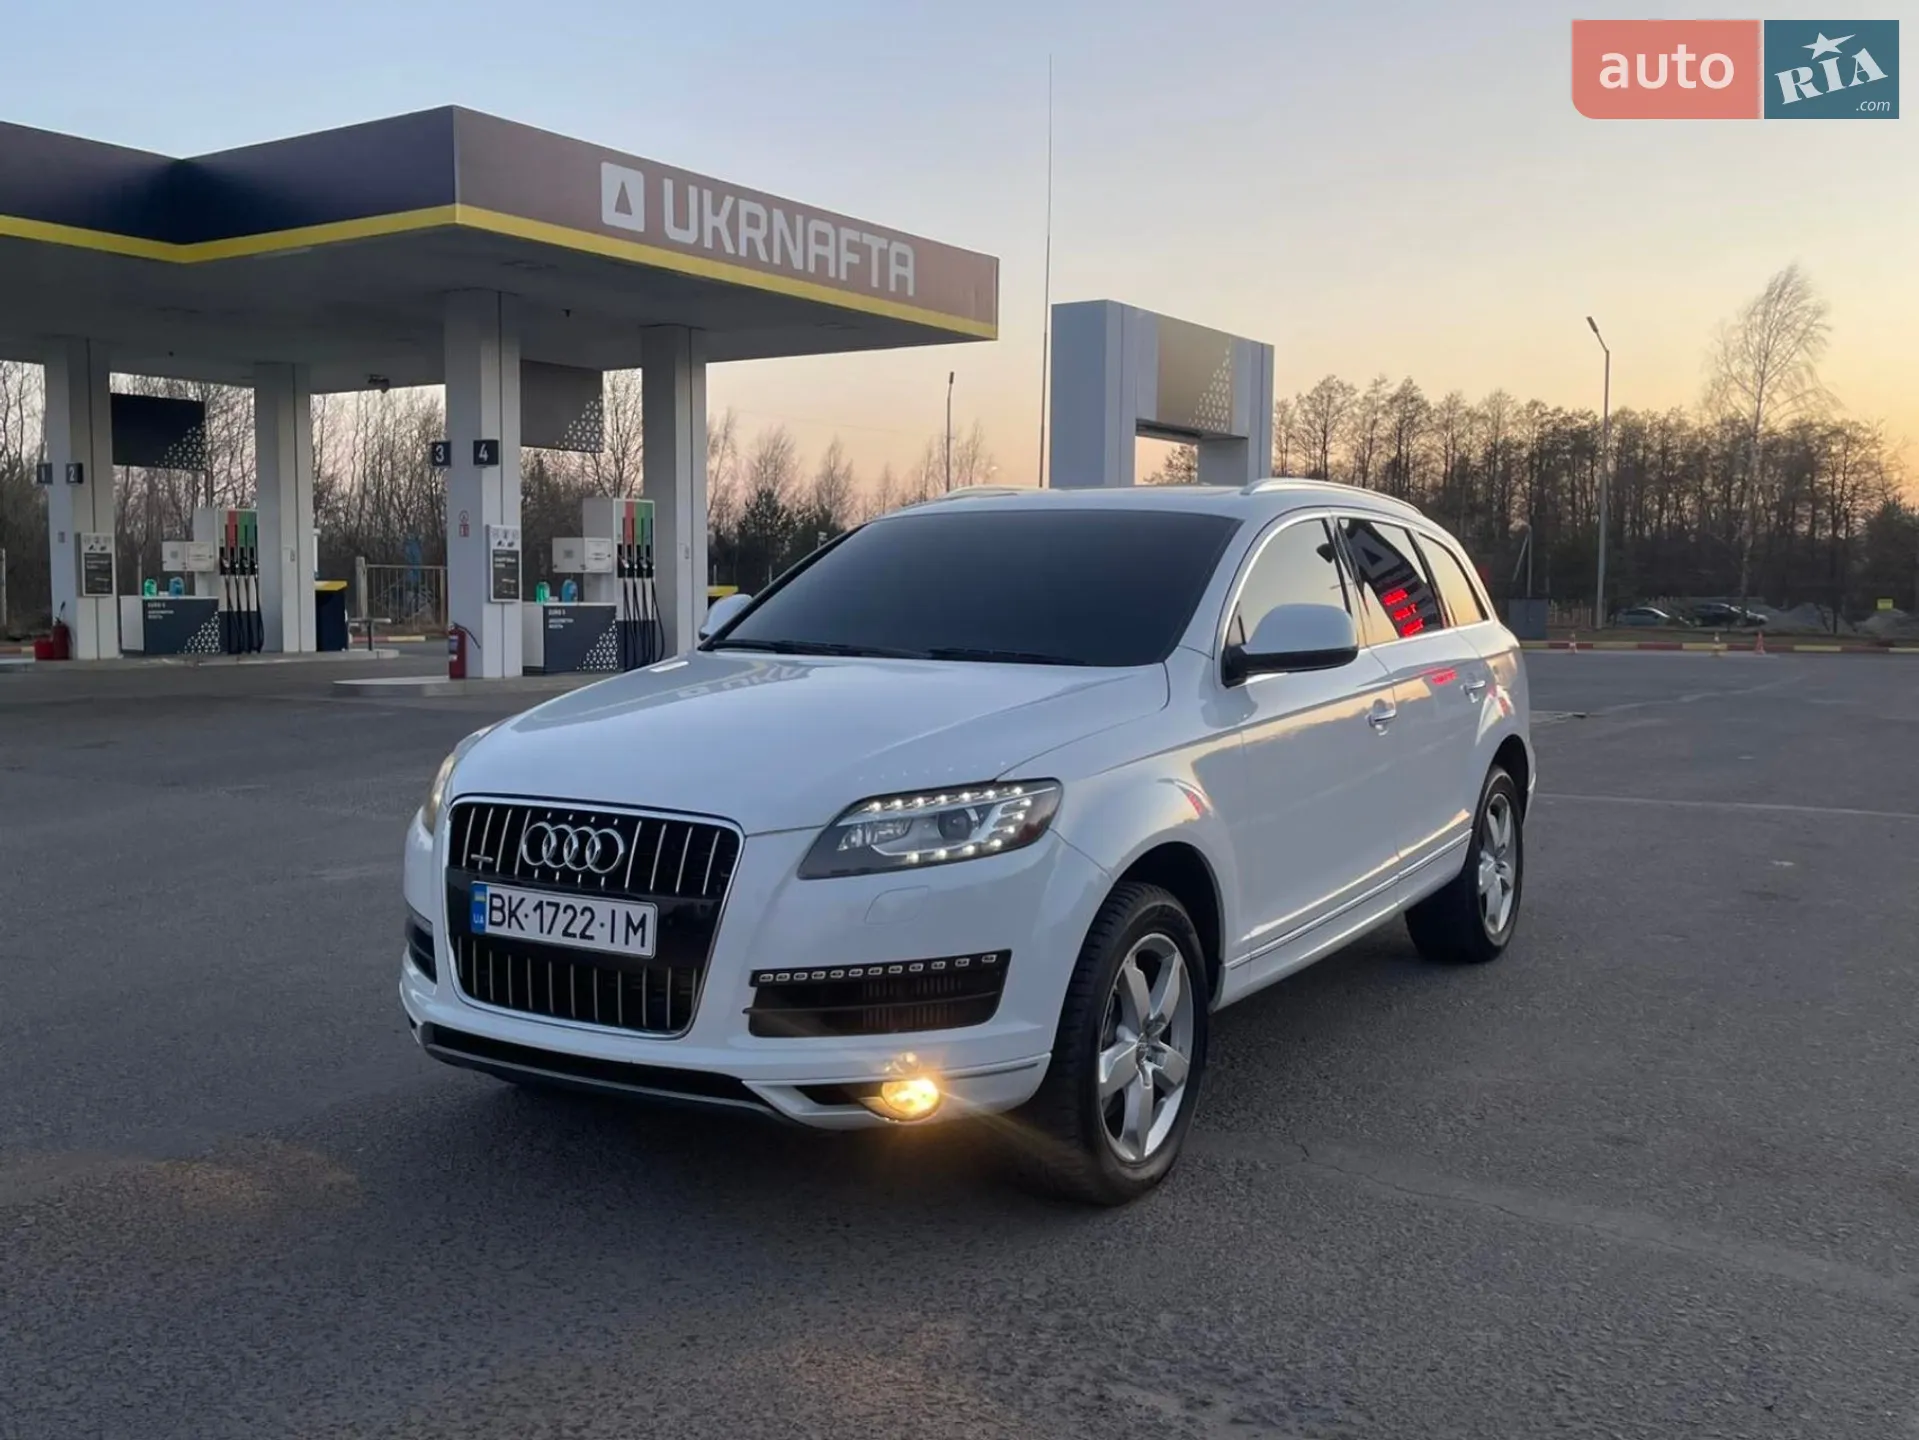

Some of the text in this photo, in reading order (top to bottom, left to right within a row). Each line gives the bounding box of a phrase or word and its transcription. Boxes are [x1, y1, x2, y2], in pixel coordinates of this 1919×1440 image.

[662, 177, 915, 297] UKRNAFTA
[435, 443, 445, 462] 3
[478, 443, 489, 461] 4
[69, 466, 75, 481] 2
